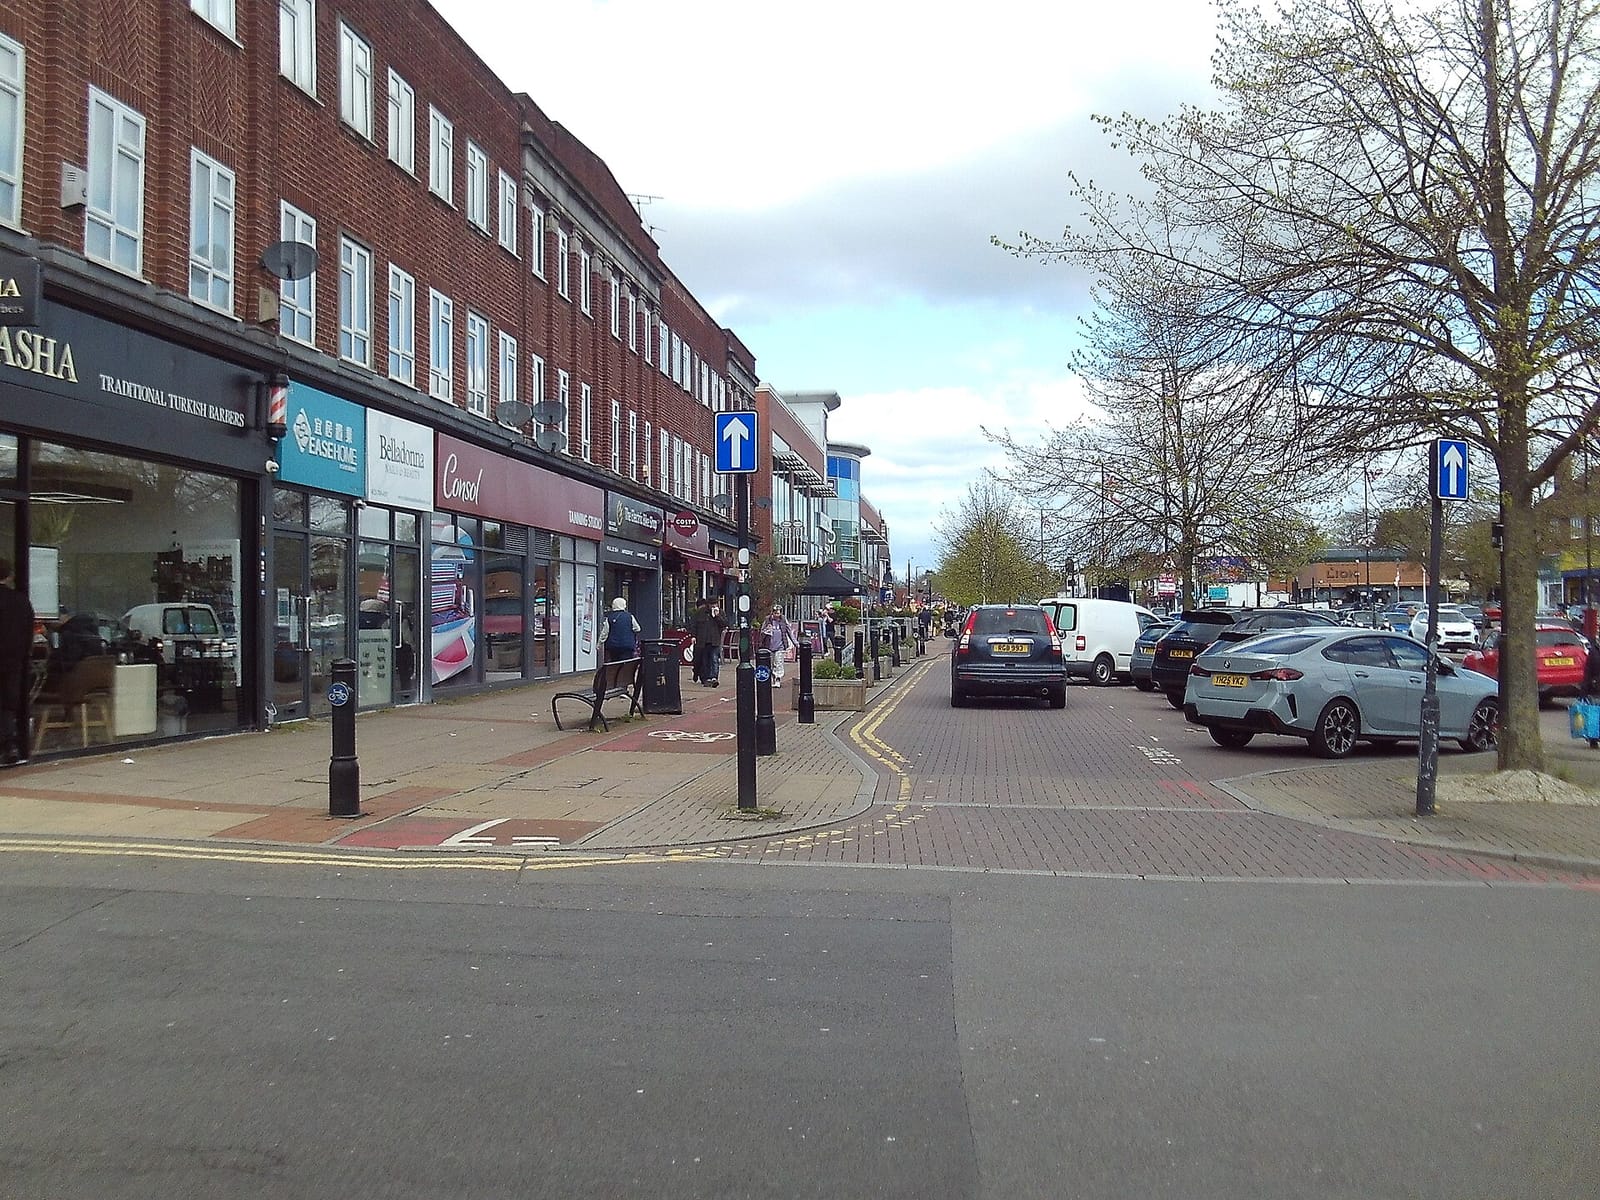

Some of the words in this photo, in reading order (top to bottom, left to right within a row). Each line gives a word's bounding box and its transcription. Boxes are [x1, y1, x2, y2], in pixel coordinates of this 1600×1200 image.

[99, 374, 167, 407] TRADITIONAL
[168, 394, 207, 418] TURKISH
[209, 405, 245, 428] BARBERS
[309, 436, 358, 466] EASEHOME
[379, 434, 425, 469] Belladonna
[443, 453, 484, 505] Consol
[568, 510, 588, 527] TANNING
[588, 515, 603, 530] STUDIO
